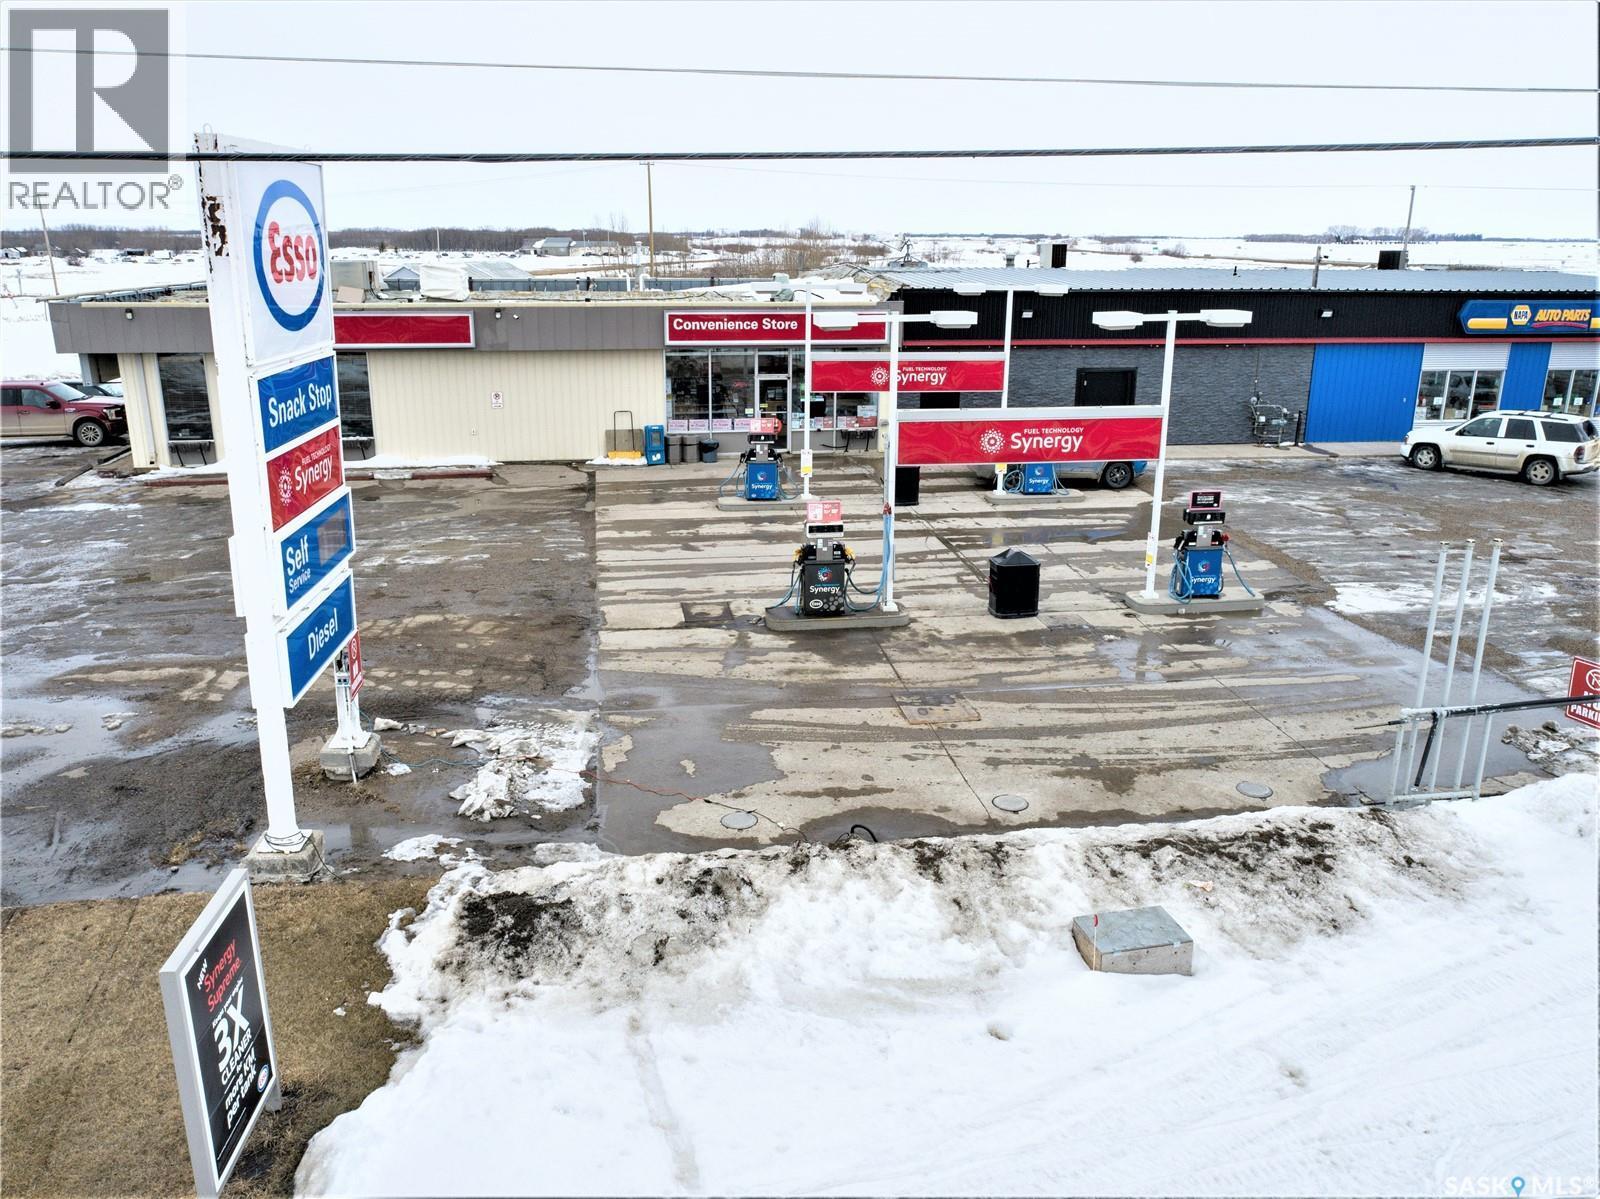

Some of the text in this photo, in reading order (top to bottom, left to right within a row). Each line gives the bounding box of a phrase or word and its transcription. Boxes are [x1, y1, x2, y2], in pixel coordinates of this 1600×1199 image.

[268, 221, 318, 284] Esso
[673, 317, 798, 330] Convenience Store
[1514, 309, 1592, 321] NAPA AUTO PARTS
[268, 382, 332, 428] Snack Stop
[1010, 432, 1084, 454] Synergy
[294, 455, 333, 495] Synergy
[286, 534, 310, 577] Self
[289, 567, 311, 594] Service
[810, 585, 840, 594] Synergy
[307, 607, 339, 661] Diesel
[1570, 704, 1600, 722] PARKI
[204, 938, 236, 993] Synergy
[207, 956, 241, 1013] Supreme
[214, 984, 250, 1073] 3X
[221, 1027, 252, 1086] CLEANER
[225, 1073, 244, 1110] more
[226, 1094, 241, 1130] per
[240, 1063, 257, 1099] tank
